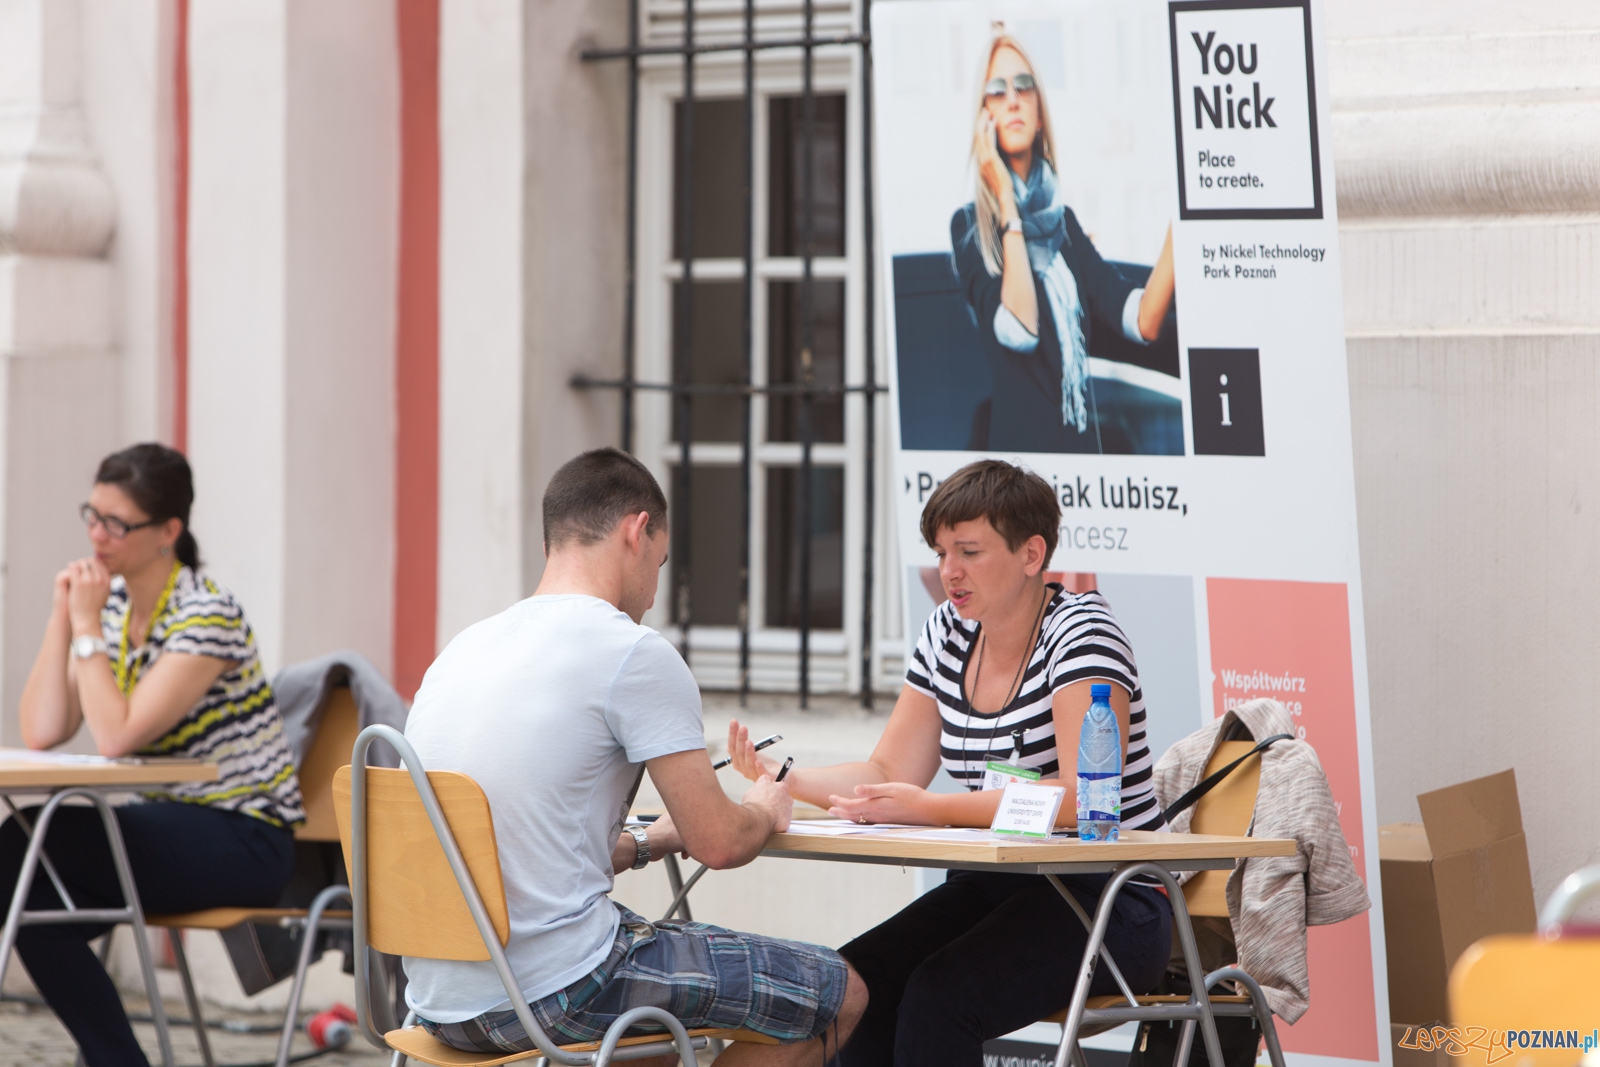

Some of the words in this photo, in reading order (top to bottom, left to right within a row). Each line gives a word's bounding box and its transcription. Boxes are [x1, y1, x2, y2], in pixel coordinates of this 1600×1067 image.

[1191, 31, 1258, 75] You
[1193, 82, 1278, 129] Nick
[1198, 149, 1236, 168] Place
[1199, 173, 1213, 189] to
[1216, 173, 1264, 189] create.
[1202, 244, 1216, 262] by
[1219, 244, 1257, 259] Nickel
[1259, 244, 1326, 263] Technology
[1203, 264, 1231, 279] Park
[1234, 264, 1277, 279] Poznań
[1100, 475, 1188, 517] lubisz,
[1221, 669, 1306, 694] Współtwórz
